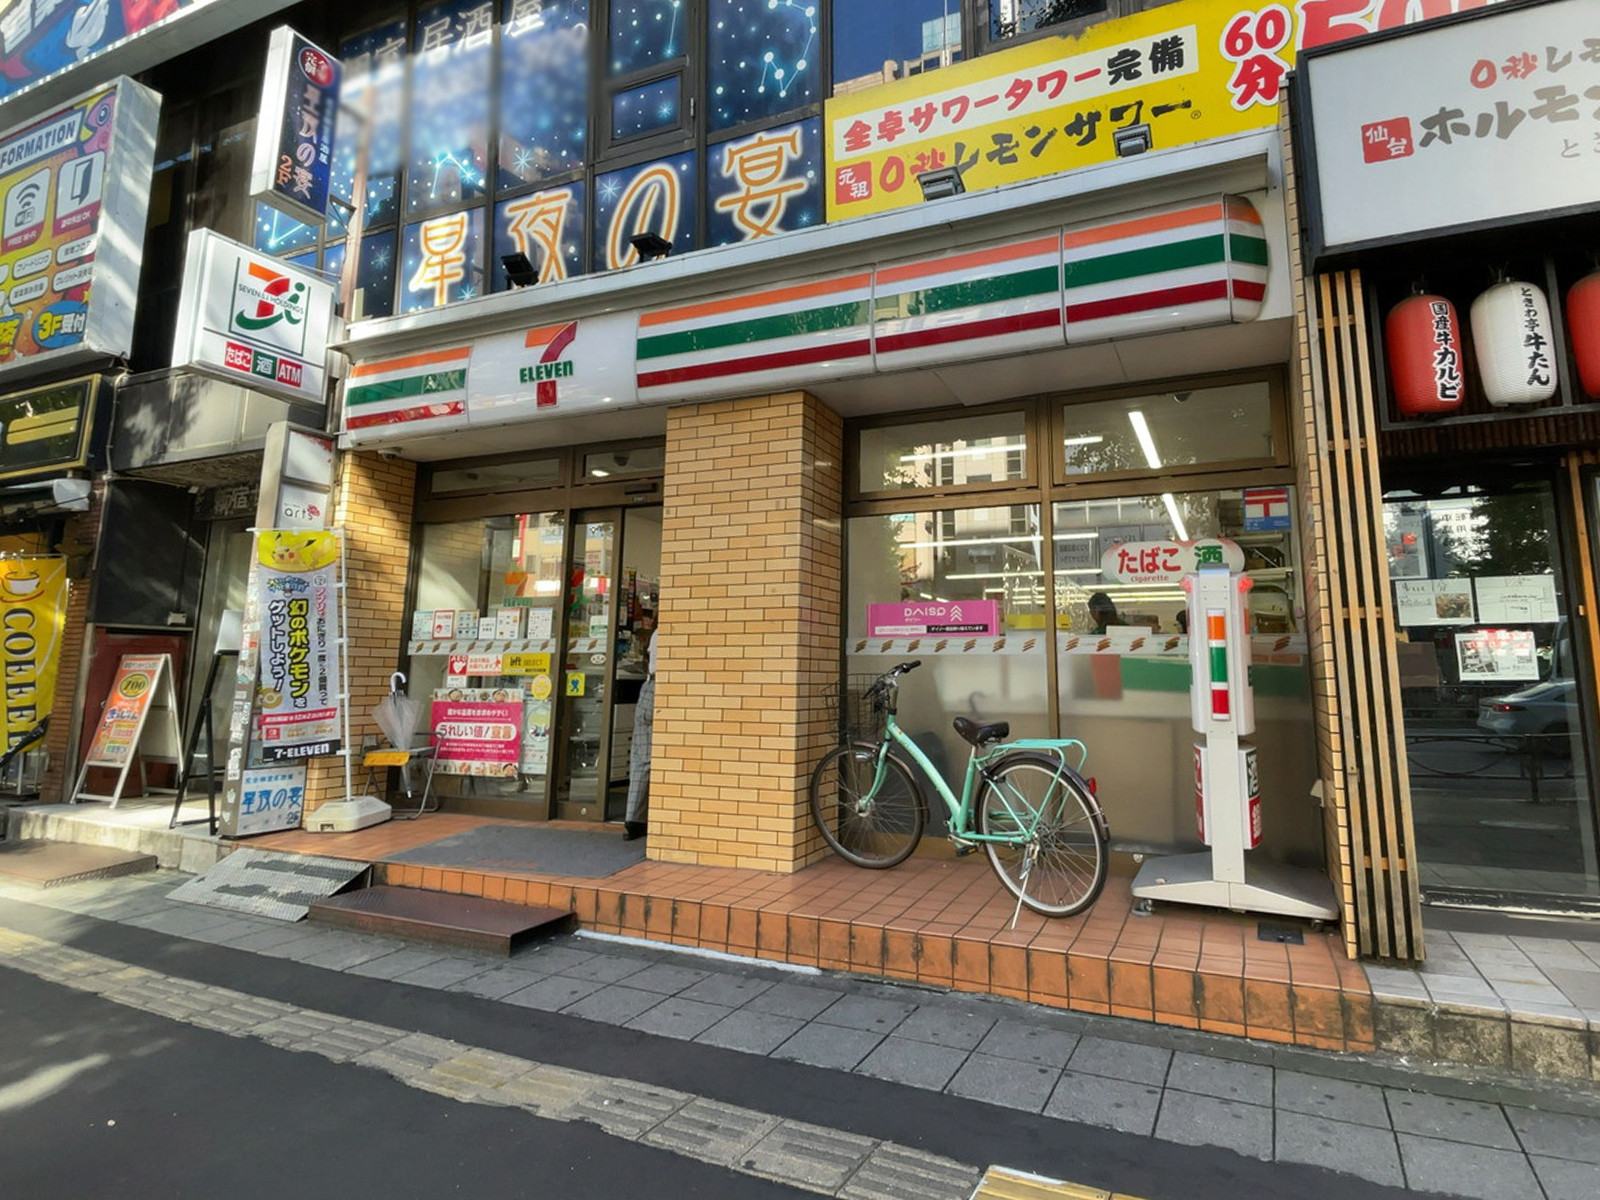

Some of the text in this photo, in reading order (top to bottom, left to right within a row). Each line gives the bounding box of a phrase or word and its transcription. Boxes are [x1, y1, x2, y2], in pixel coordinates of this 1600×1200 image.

[843, 35, 1185, 153] 全卓サワータワー完備
[1366, 126, 1408, 157] 仙台
[838, 167, 869, 199] 元祖
[409, 129, 804, 307] 星夜の宴
[255, 355, 273, 375] 酒
[1431, 302, 1461, 400] 国産牛カルビ
[278, 363, 302, 382] ATM
[1118, 547, 1182, 573] たばこ
[904, 607, 946, 617] DAISO
